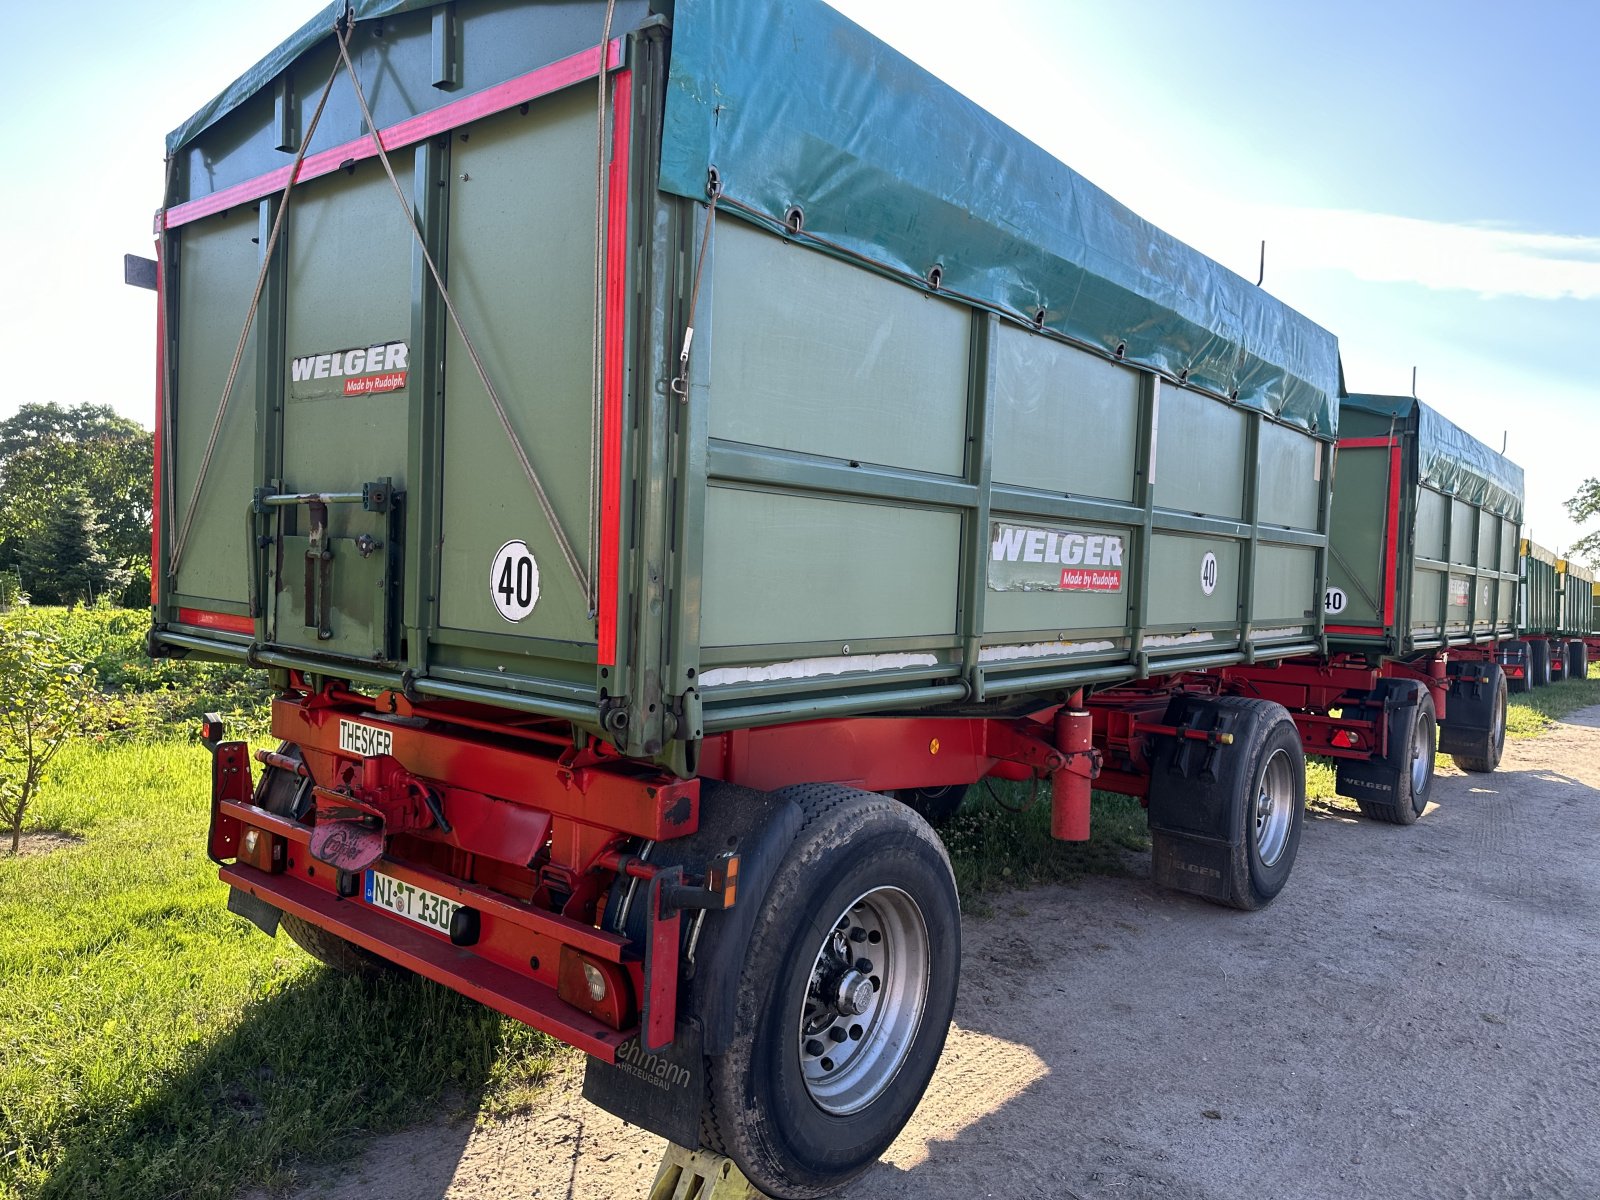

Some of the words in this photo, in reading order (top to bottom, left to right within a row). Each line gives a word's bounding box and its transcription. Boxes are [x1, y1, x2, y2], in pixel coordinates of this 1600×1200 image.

[292, 342, 408, 381] WELGER
[346, 379, 364, 391] Made
[365, 379, 374, 392] by
[992, 527, 1123, 566] WELGER
[498, 556, 532, 608] 40
[1063, 572, 1083, 585] Made
[1083, 572, 1092, 586] by
[1203, 559, 1215, 587] 40
[1325, 592, 1342, 610] 40
[340, 720, 391, 757] THESKER
[375, 874, 393, 908] NI
[405, 885, 415, 915] T
[418, 892, 461, 930] 130
[615, 1062, 670, 1091] AHRZEUGBAU
[616, 1038, 691, 1088] ehmann
